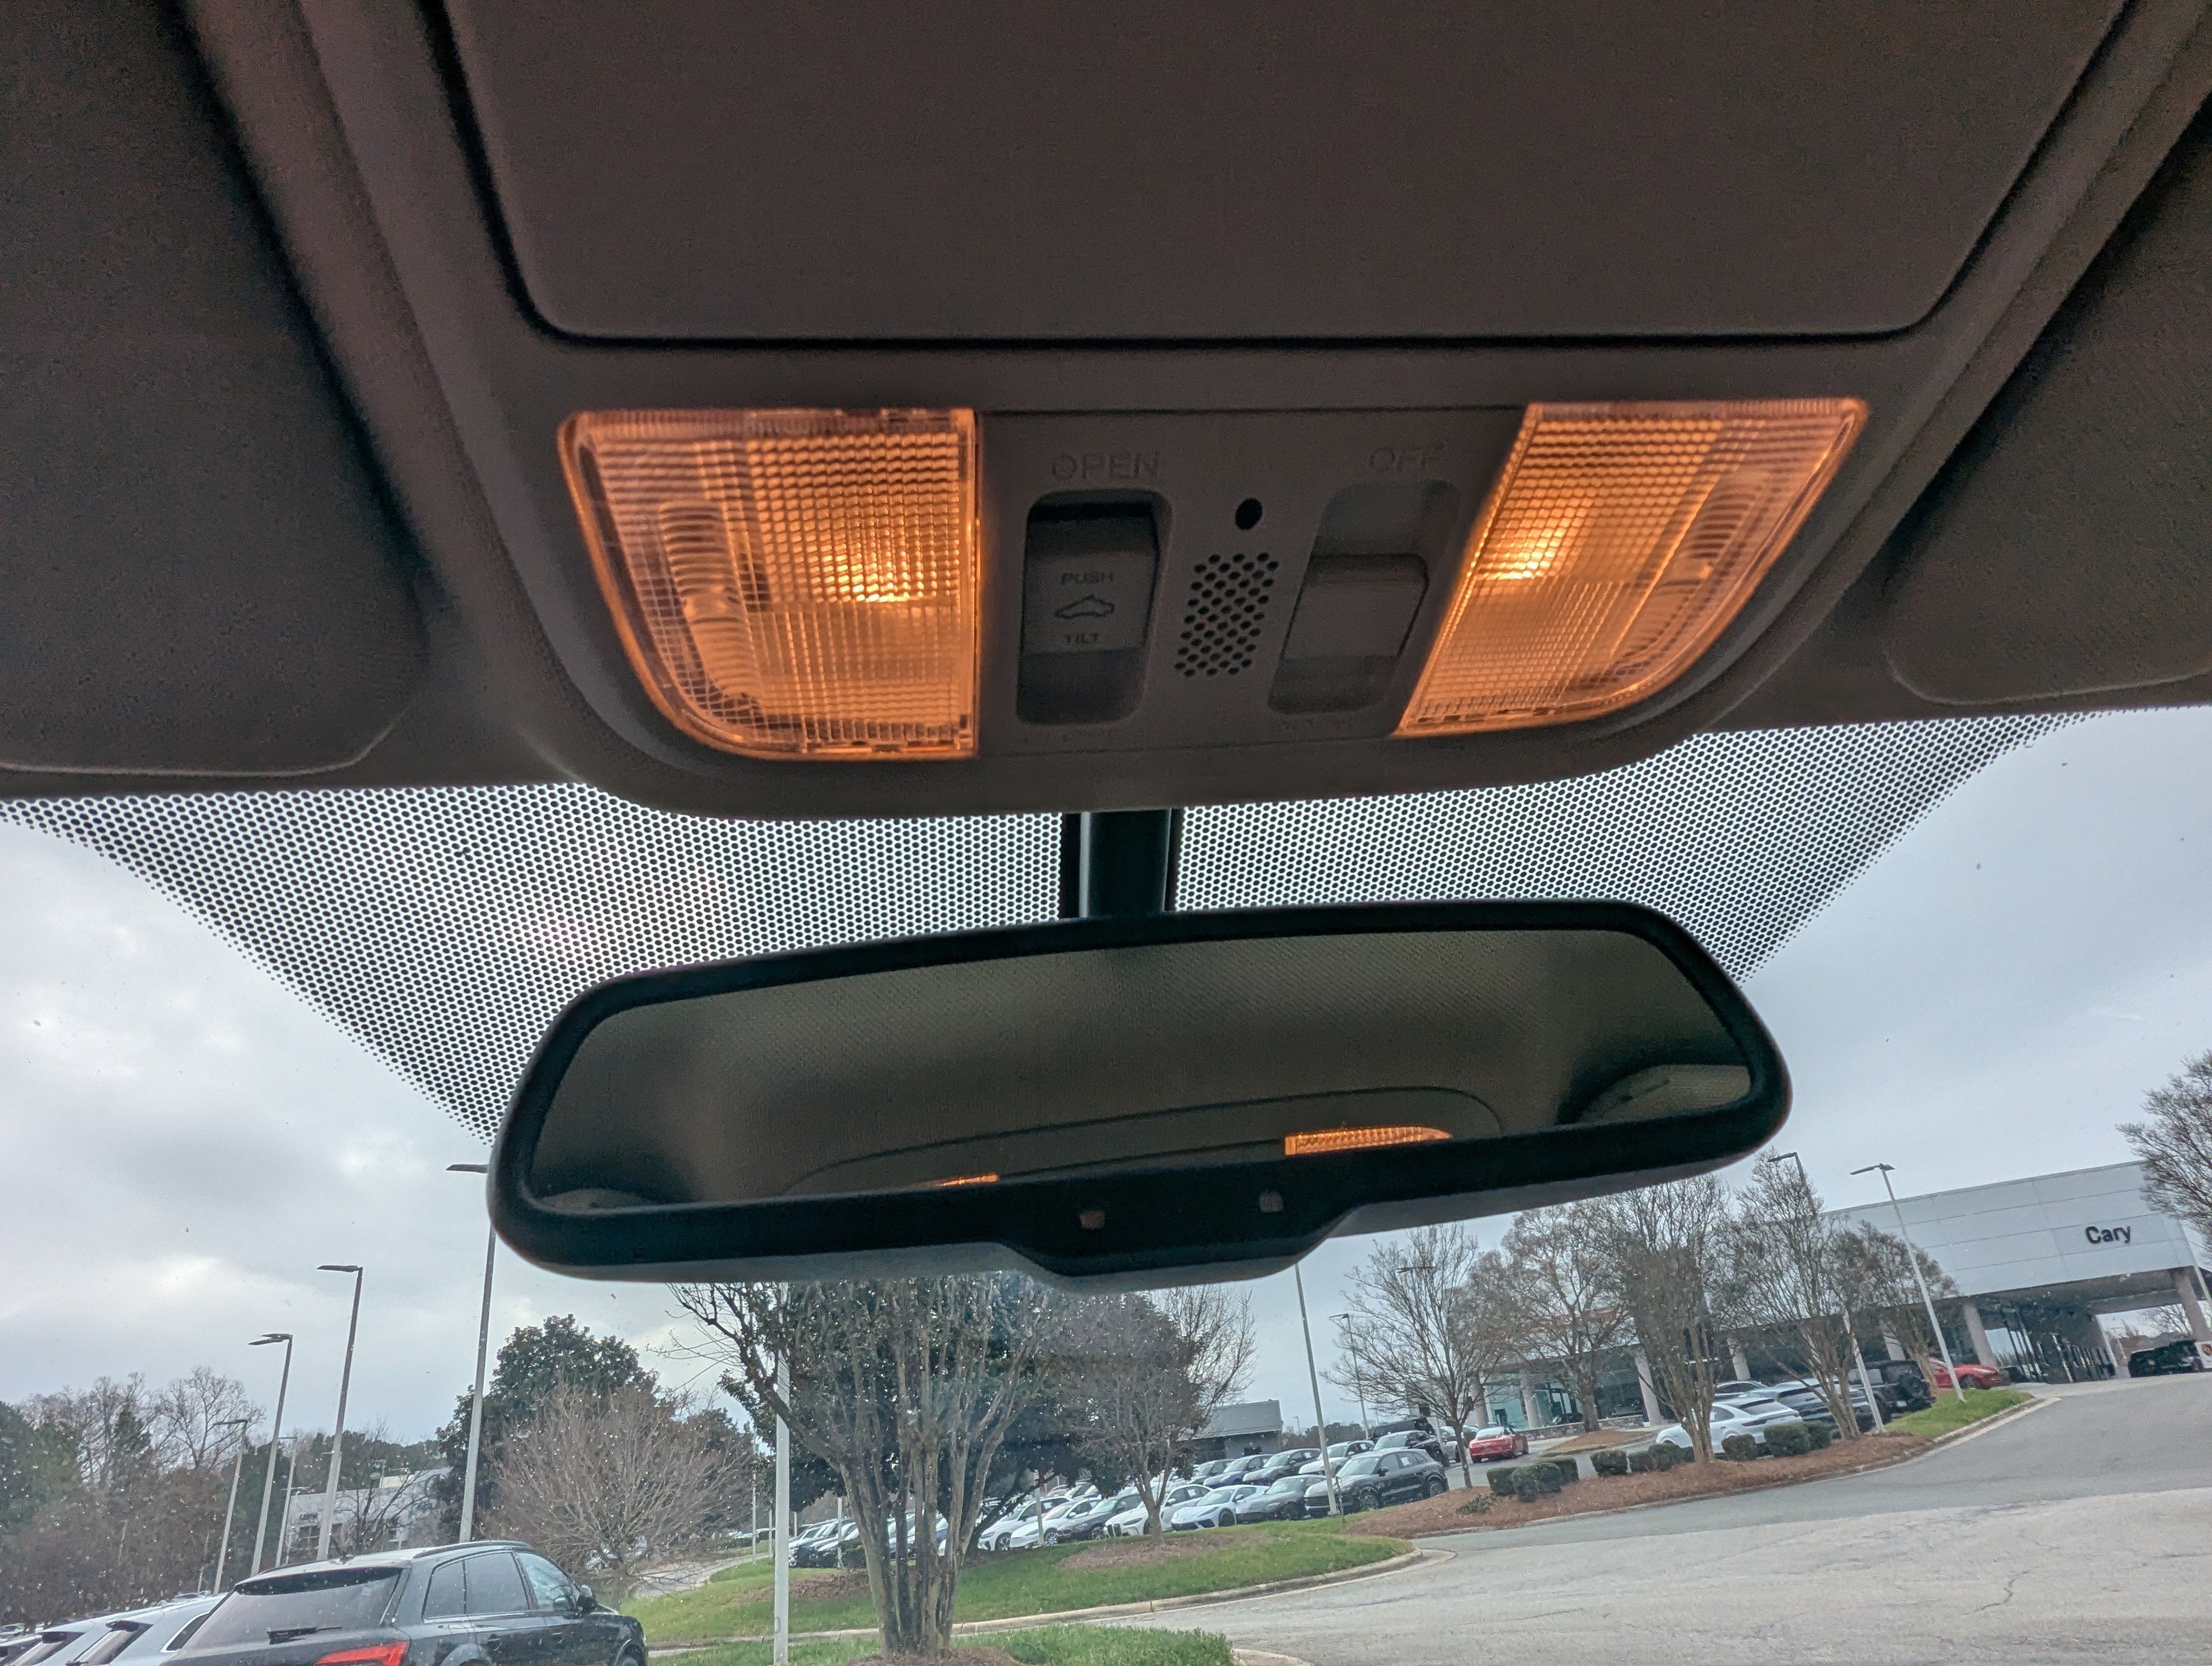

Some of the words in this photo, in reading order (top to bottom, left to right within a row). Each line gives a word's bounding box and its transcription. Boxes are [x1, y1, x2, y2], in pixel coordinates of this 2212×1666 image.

[1051, 451, 1160, 480] OPEN
[1060, 571, 1114, 585] PUSH
[1064, 633, 1099, 644] TILT
[2085, 1226, 2131, 1244] Cary
